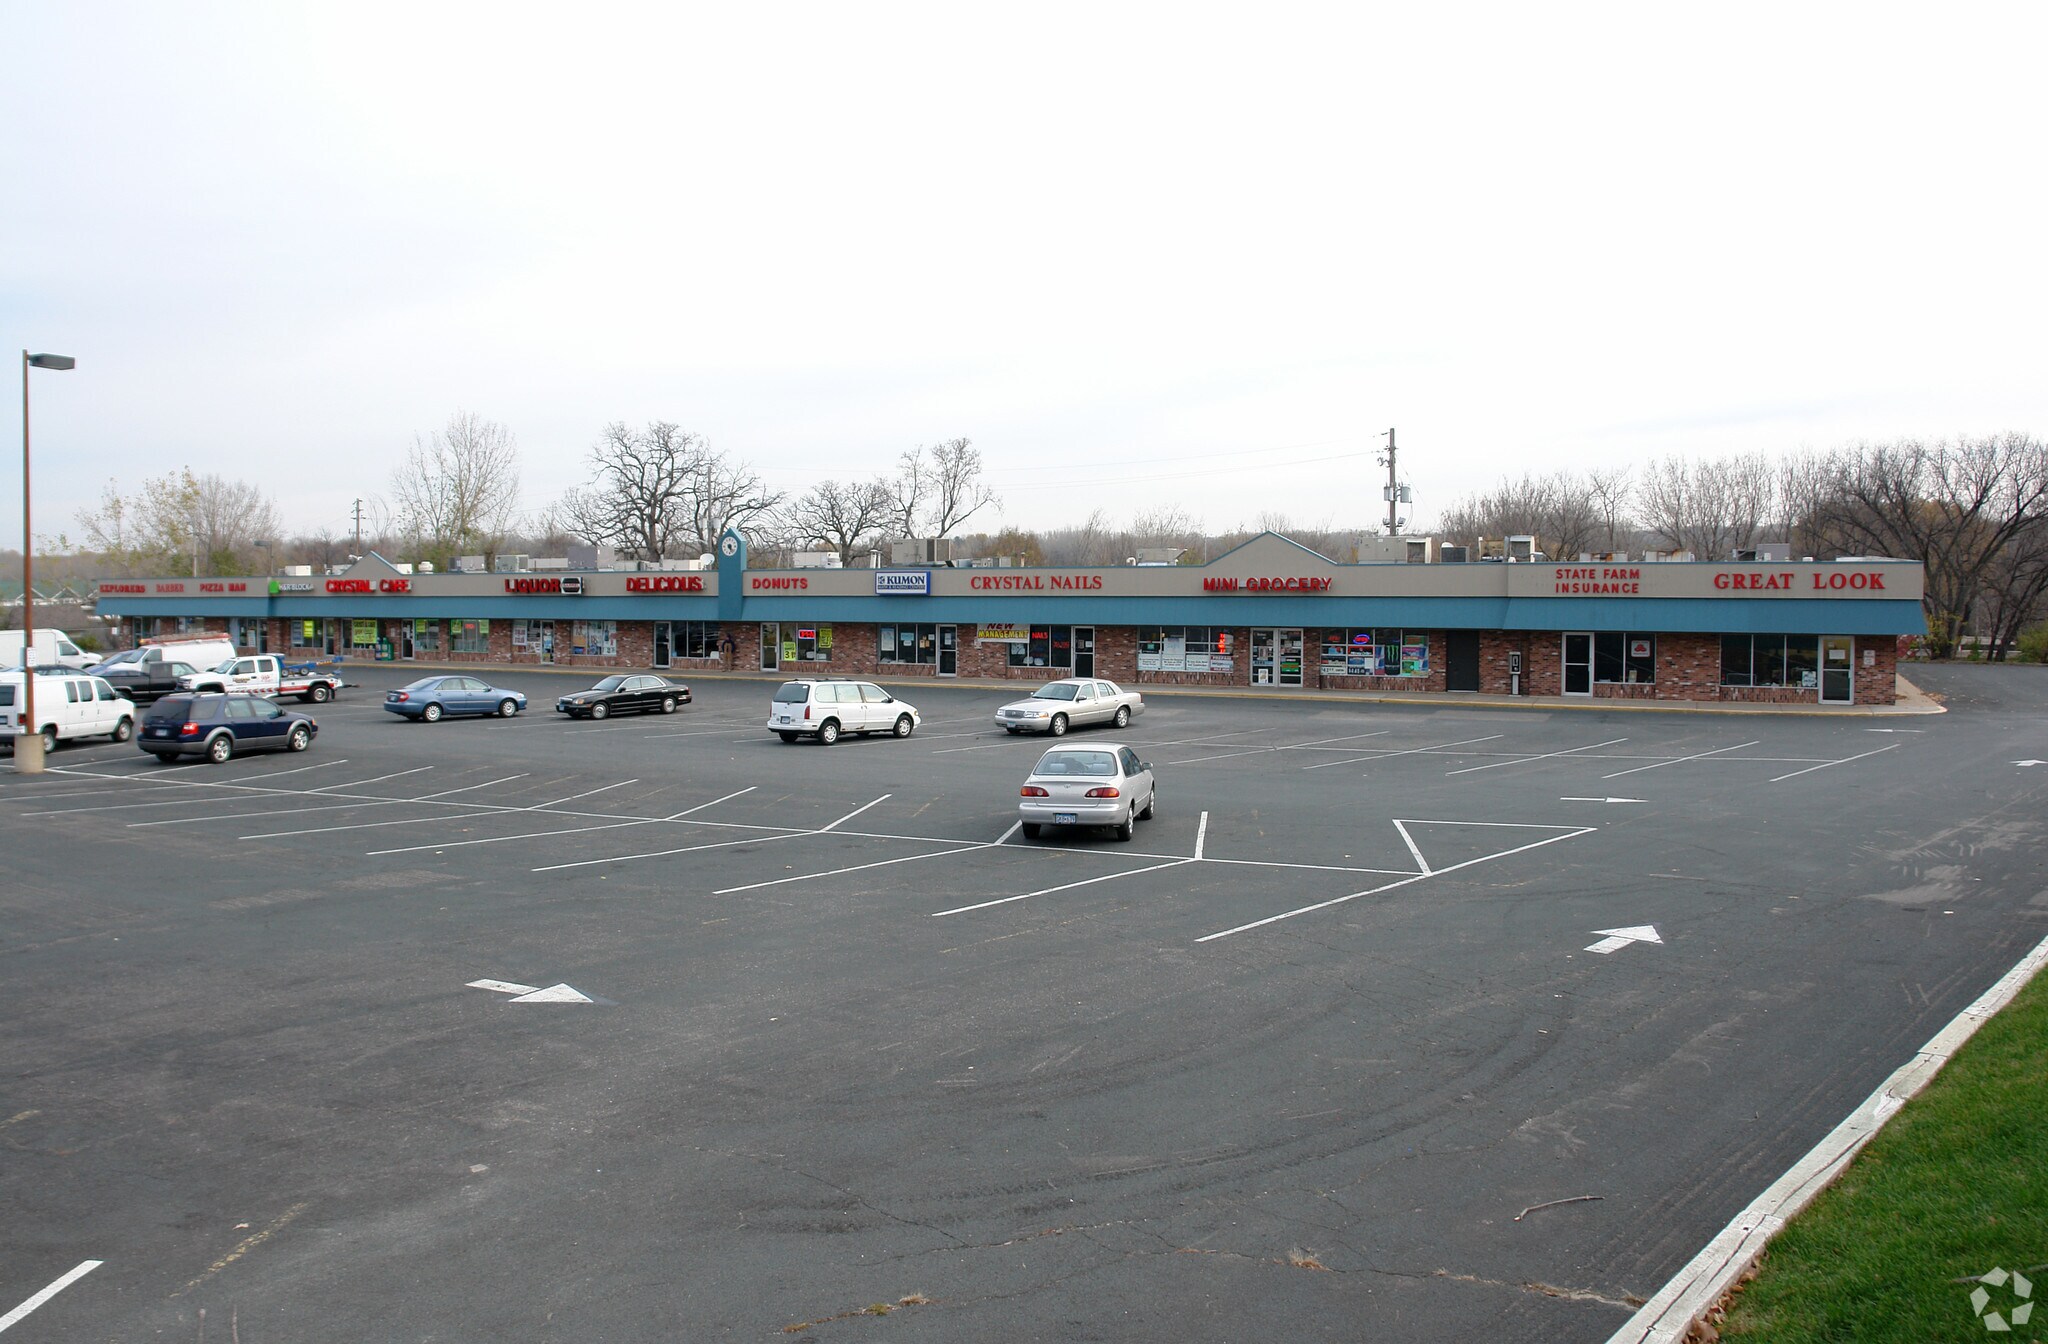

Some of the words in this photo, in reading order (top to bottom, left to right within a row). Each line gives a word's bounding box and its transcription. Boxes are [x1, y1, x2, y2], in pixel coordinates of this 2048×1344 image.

[886, 575, 925, 585] KUMON
[1555, 569, 1596, 580] STATE
[1603, 569, 1640, 580] FARM
[1714, 572, 1795, 590] GREAT
[1812, 572, 1886, 590] LOOK
[200, 583, 224, 592] PIZZA
[325, 579, 372, 593] CRYSTAL
[379, 579, 410, 593] CAFE
[504, 578, 561, 593] LIQUOR
[626, 576, 703, 592] DELICIOUS
[752, 578, 808, 589] DONUTS
[970, 576, 1044, 590] CRYSTAL
[1050, 575, 1103, 590] NAILS
[1203, 577, 1239, 591] MINI
[1245, 577, 1333, 592] GROCERY
[1555, 582, 1640, 594] INSURANCE
[977, 630, 1029, 639] MANAGEMENT
